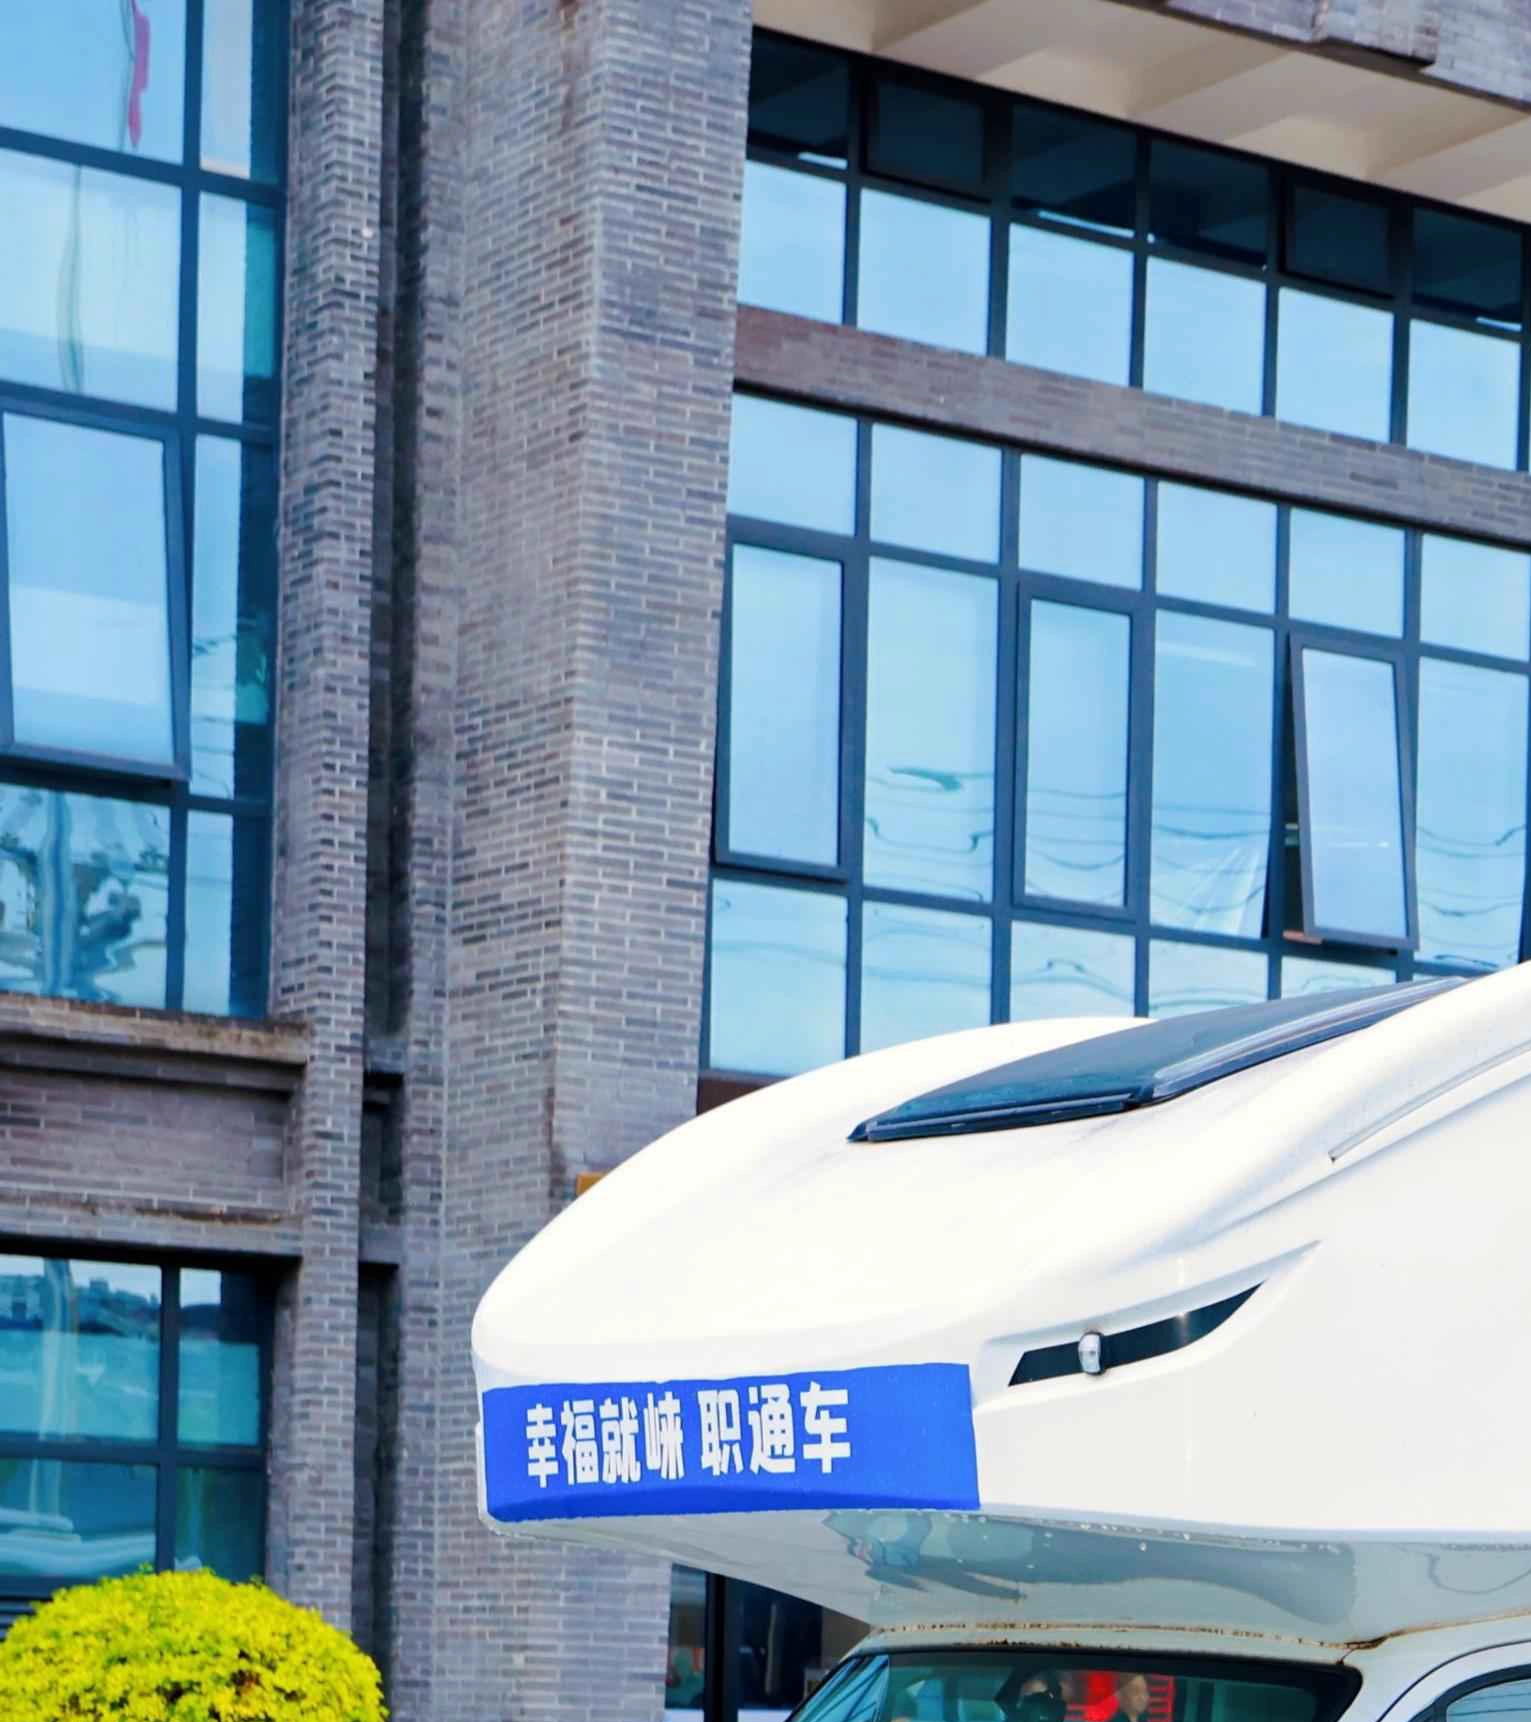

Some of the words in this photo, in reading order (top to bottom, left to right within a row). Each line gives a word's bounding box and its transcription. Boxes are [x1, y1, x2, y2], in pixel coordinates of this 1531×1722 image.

[525, 1392, 685, 1488] 幸福就崃
[699, 1381, 852, 1476] 职通车
